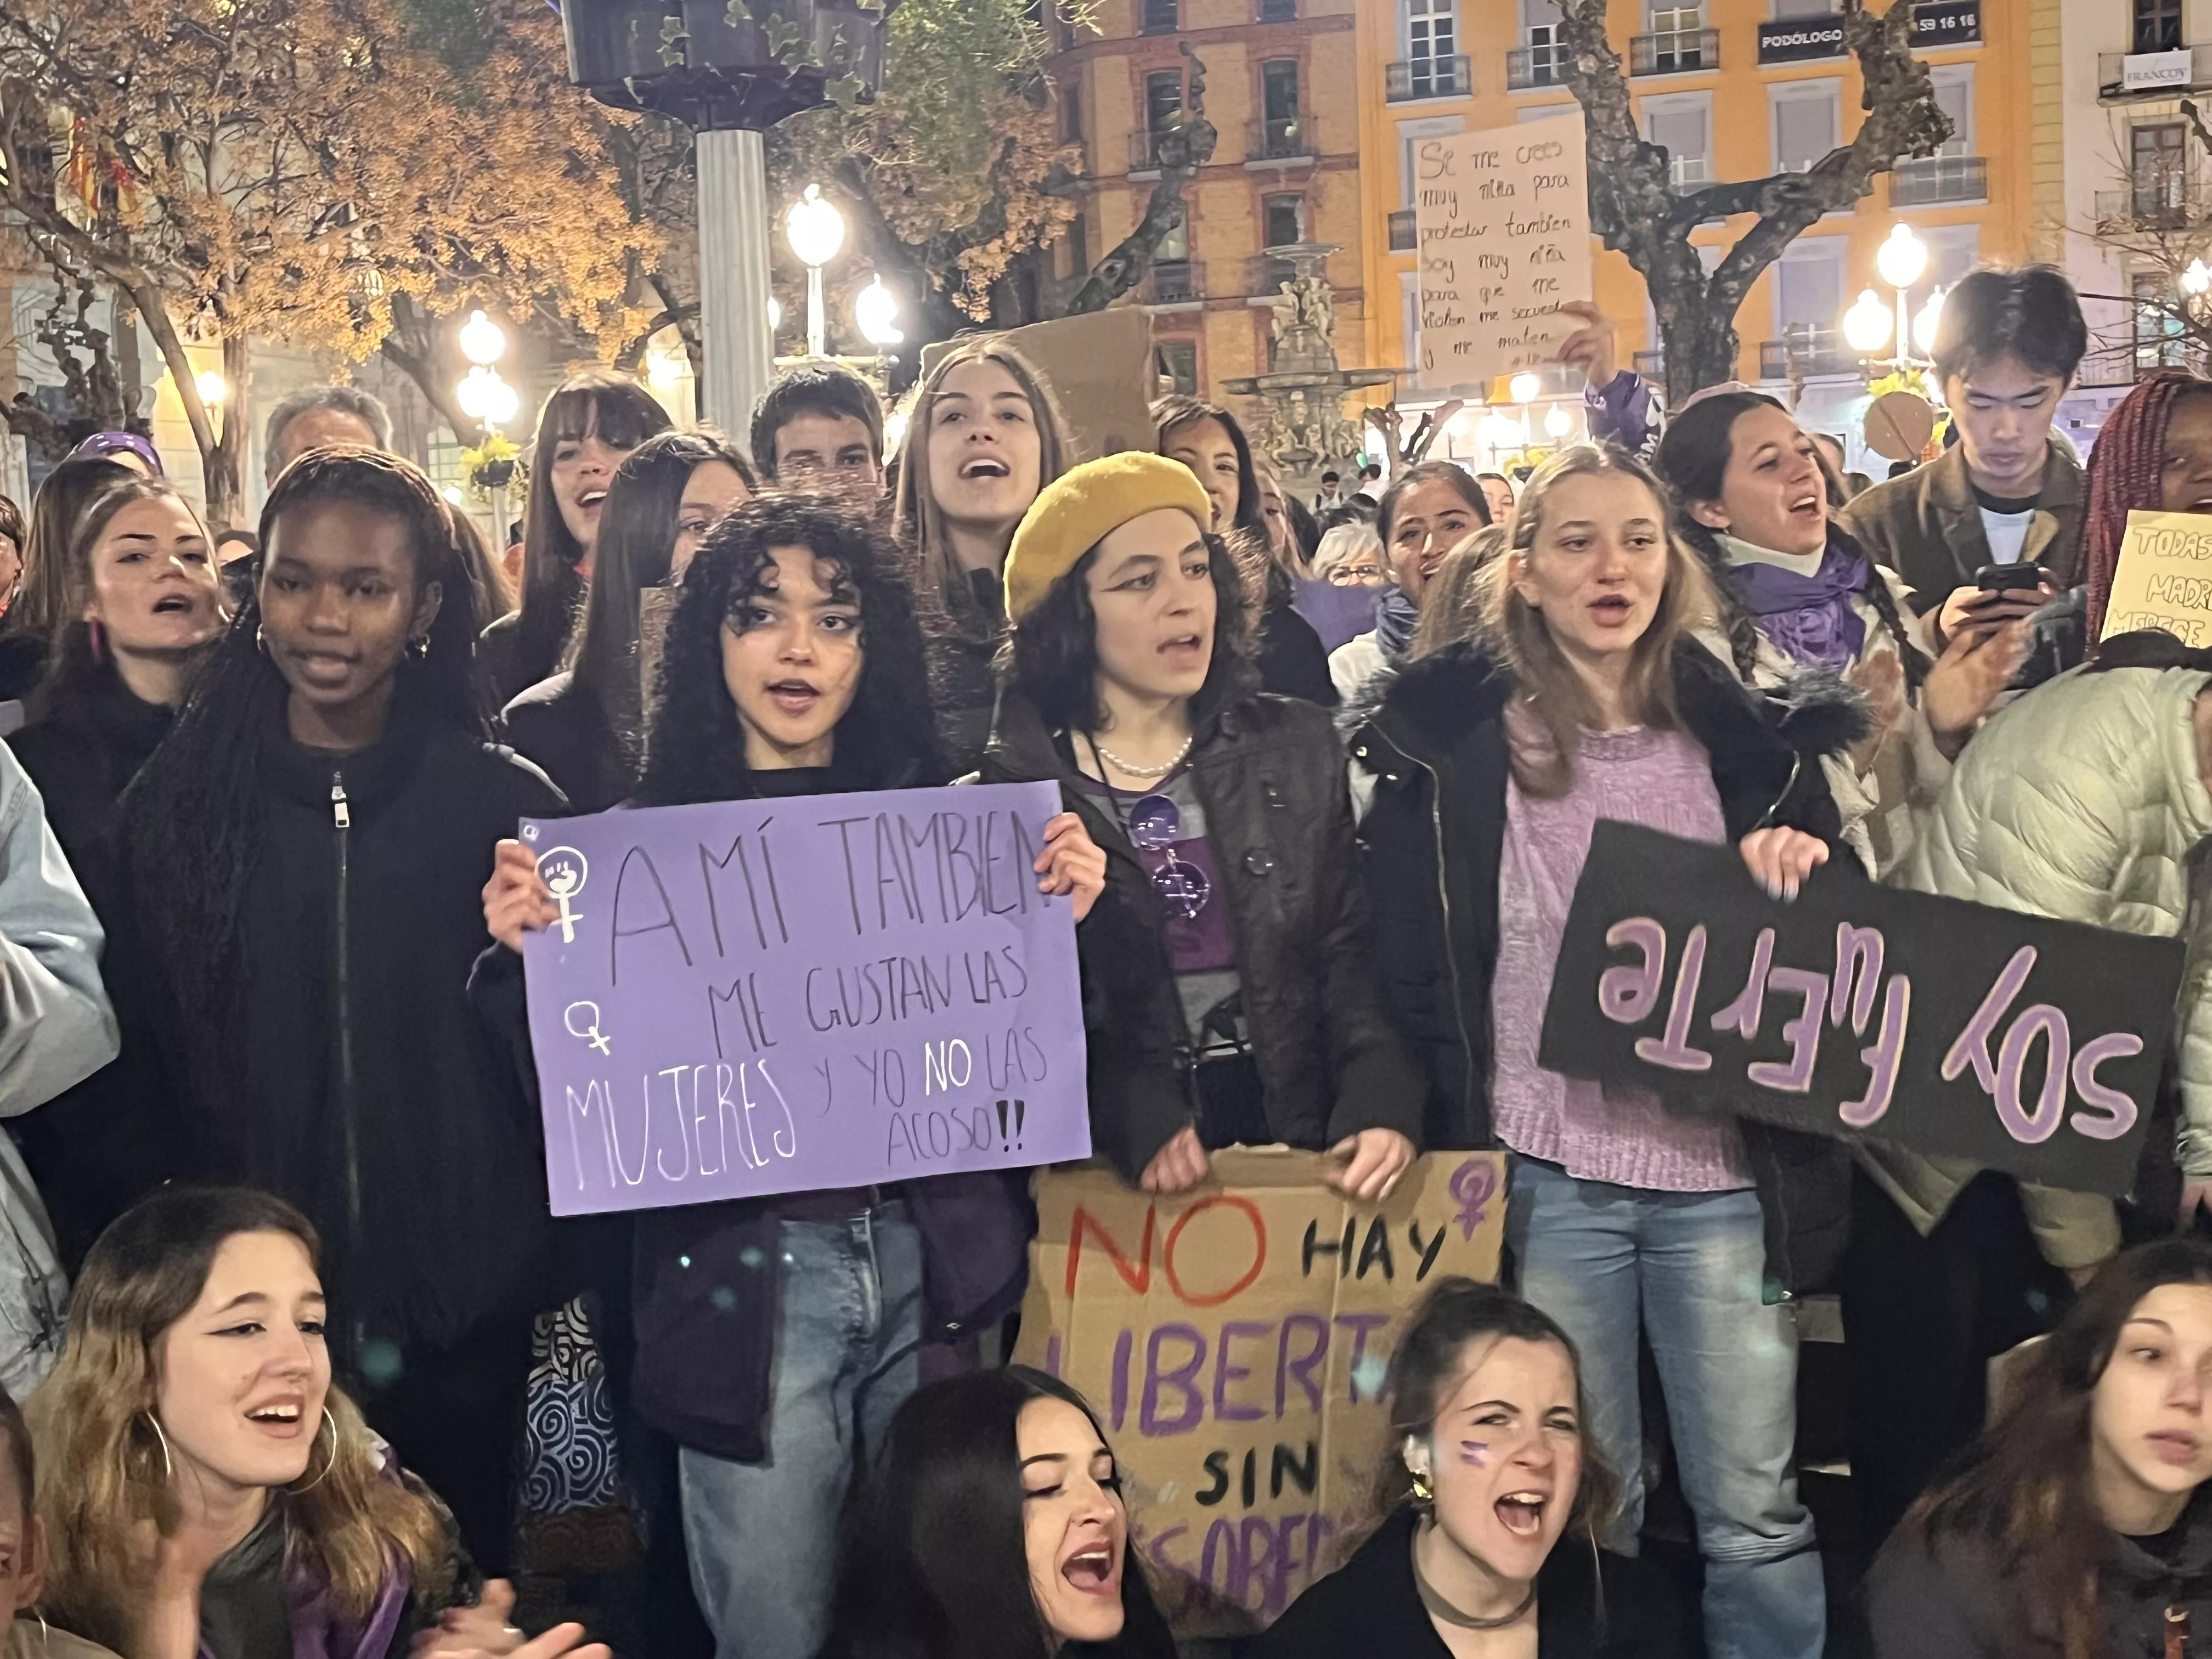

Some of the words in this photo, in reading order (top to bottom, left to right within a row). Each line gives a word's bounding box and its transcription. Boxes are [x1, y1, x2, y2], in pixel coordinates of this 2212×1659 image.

[1762, 29, 1842, 48] PODÓLOGO
[1471, 150, 1500, 169] me
[1532, 278, 1560, 295] me
[2146, 573, 2212, 611] MADR
[611, 845, 693, 987] A
[708, 972, 778, 1058] ME
[806, 956, 952, 1032] GUSTAN
[964, 945, 1029, 1004] LAS
[565, 1058, 797, 1191] MUJERES
[854, 1048, 906, 1108] YO
[924, 1039, 972, 1096] NO
[985, 1026, 1048, 1092] LAS
[1064, 1194, 1268, 1308] NO
[1302, 1214, 1447, 1283] HAY
[1194, 1438, 1318, 1510] SIN
